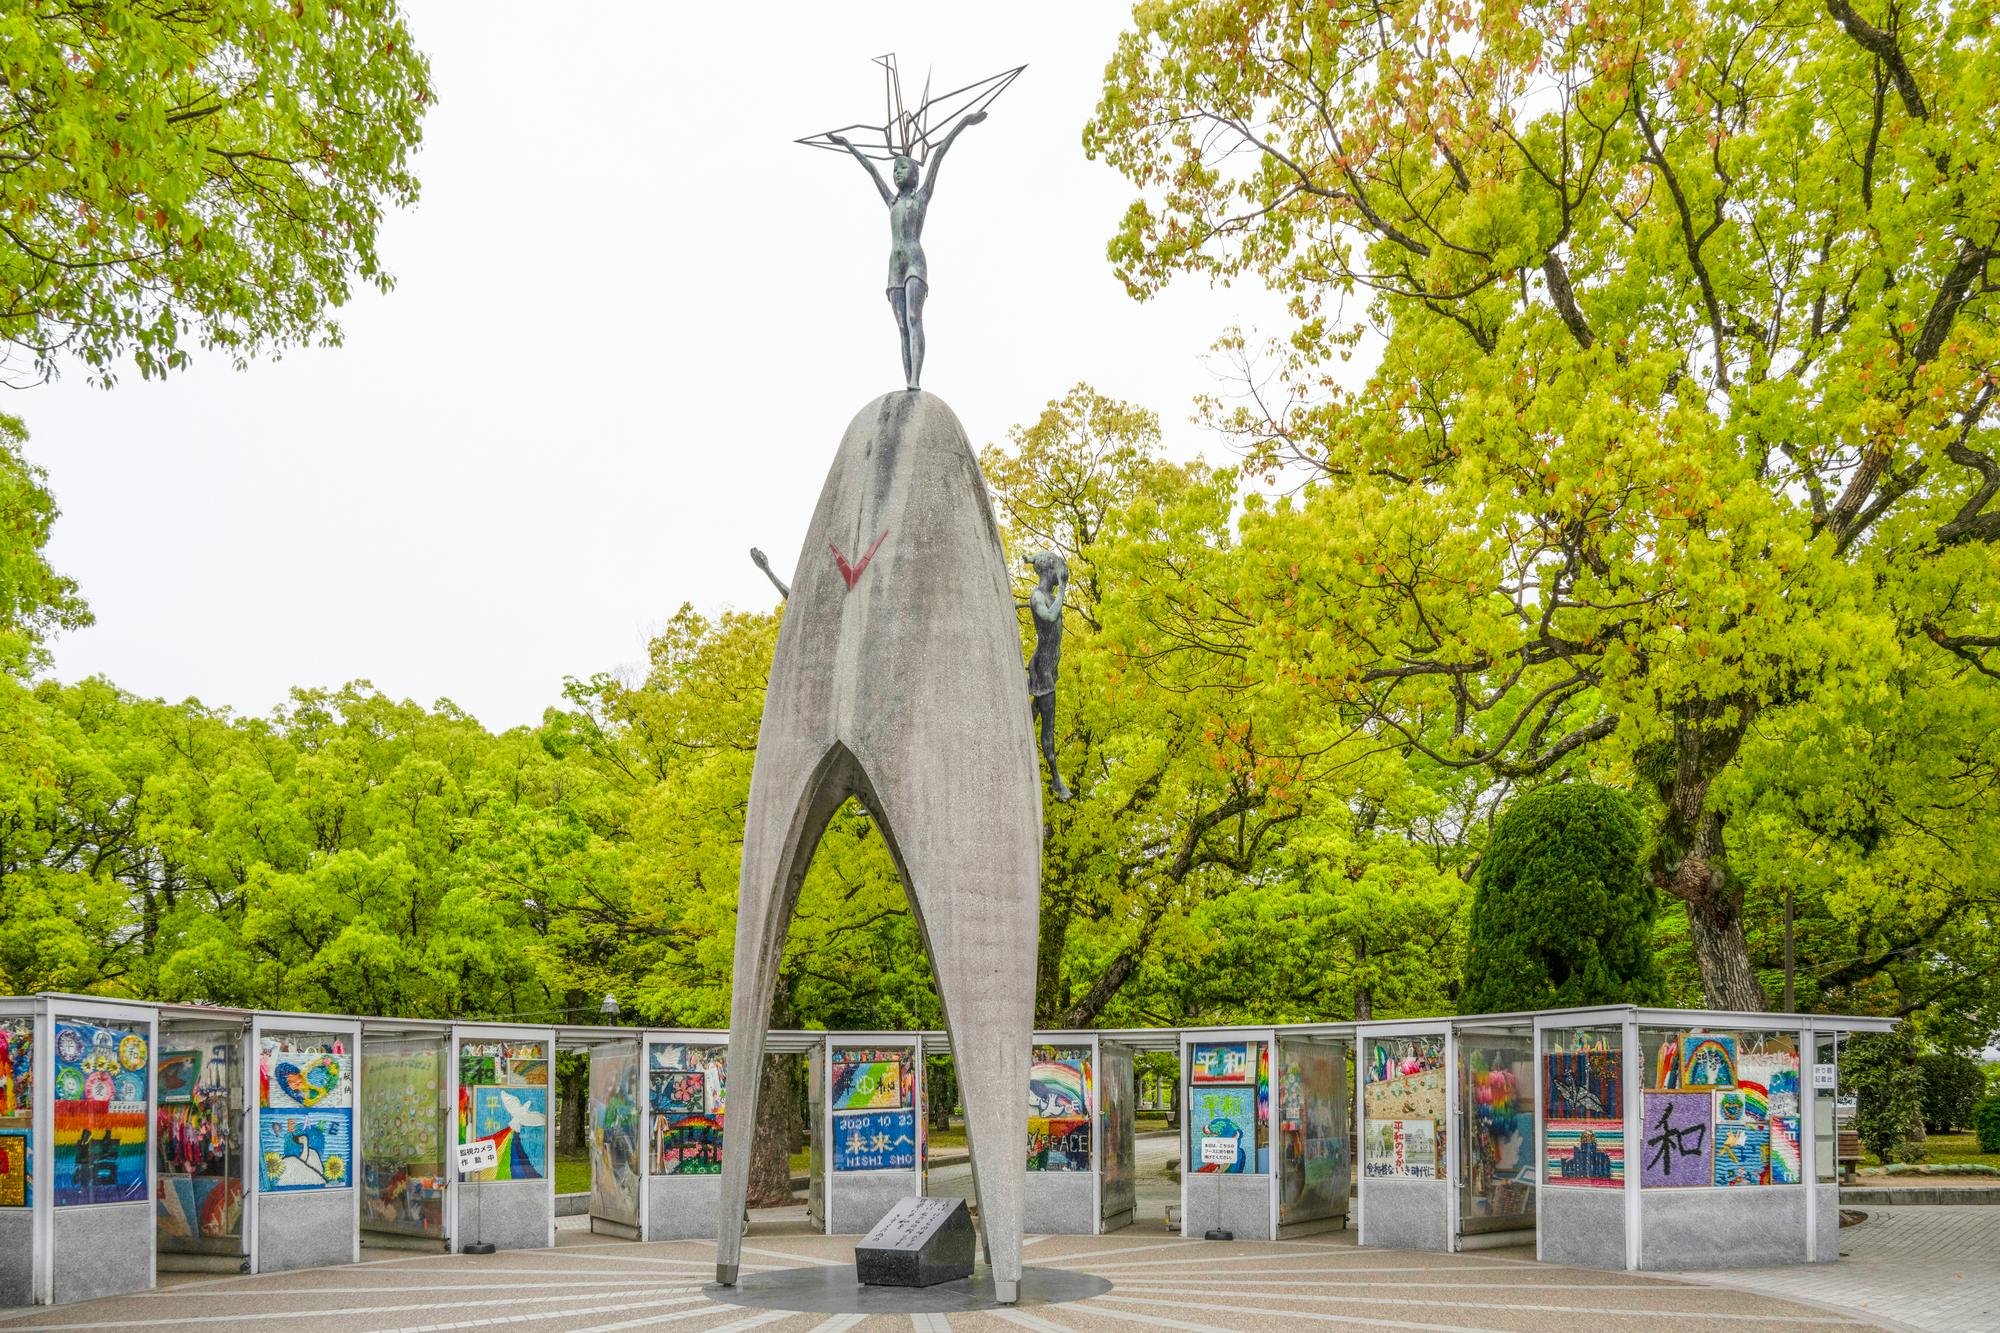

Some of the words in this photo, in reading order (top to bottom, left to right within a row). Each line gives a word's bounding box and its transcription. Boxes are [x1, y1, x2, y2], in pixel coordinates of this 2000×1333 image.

[271, 1114, 340, 1137] PEACE
[840, 1117, 870, 1130] 2020
[877, 1115, 892, 1127] 10
[845, 1131, 914, 1155] 未来へ
[1041, 1134, 1089, 1153] PEACE
[1646, 1102, 1706, 1176] 和
[460, 1145, 493, 1157] 監視カメラ
[846, 1156, 883, 1168] NISHI
